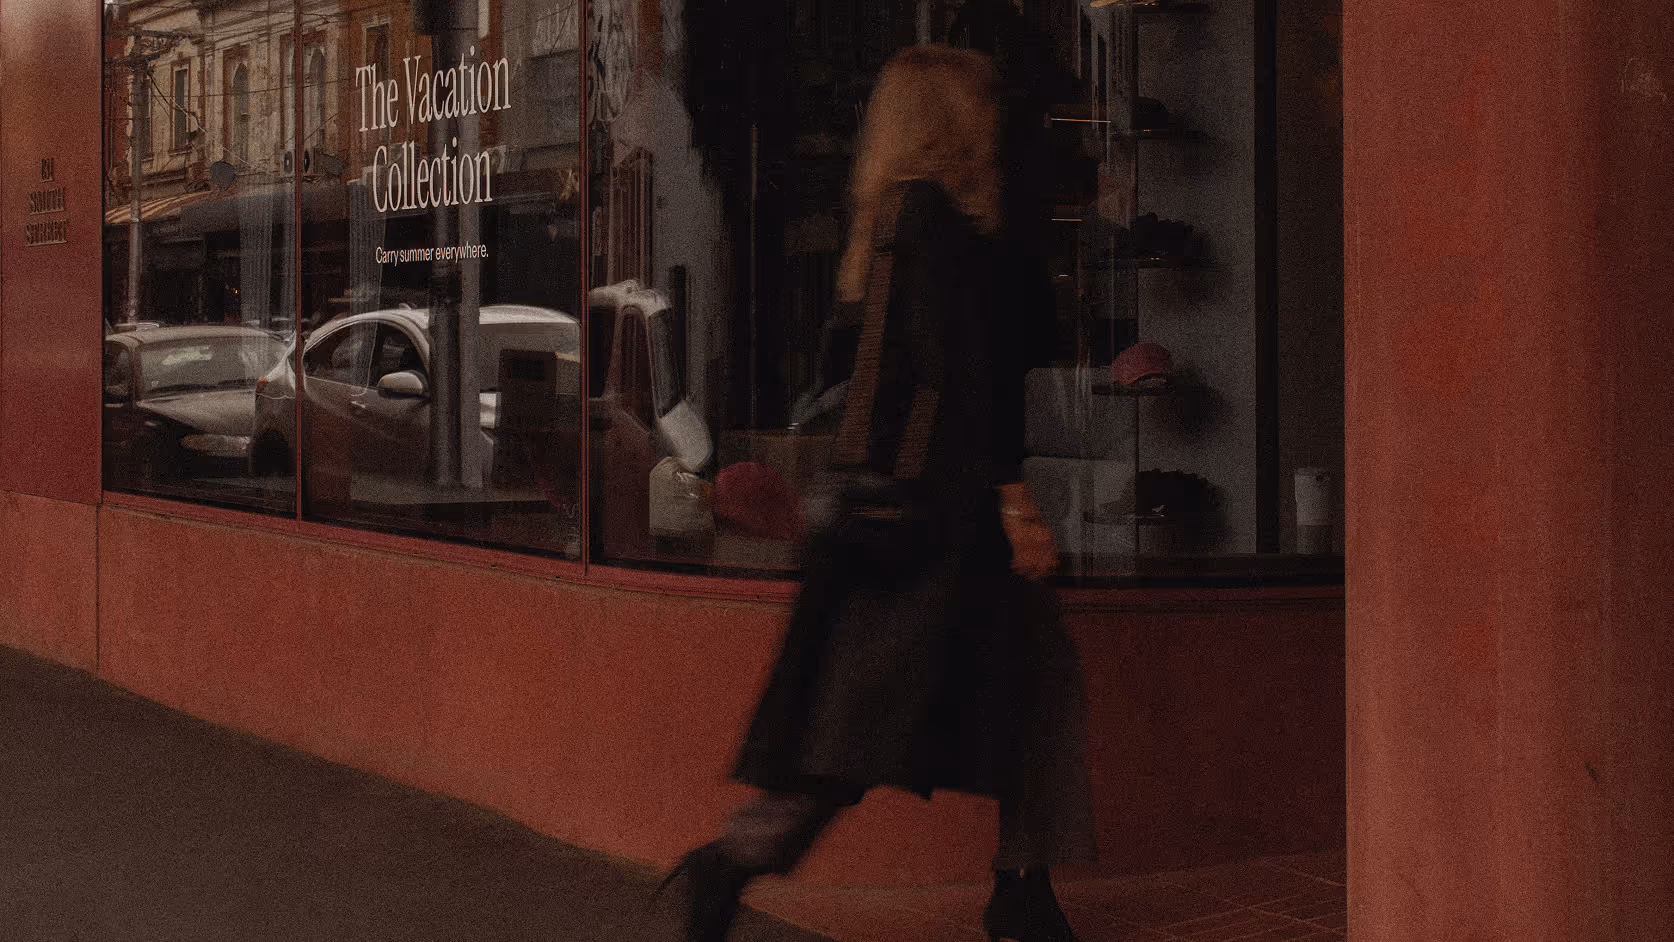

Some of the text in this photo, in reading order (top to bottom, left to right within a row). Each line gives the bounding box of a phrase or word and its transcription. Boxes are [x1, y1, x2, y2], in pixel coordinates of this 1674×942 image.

[356, 63, 399, 132] The
[402, 45, 512, 125] Vacation
[373, 136, 493, 213] Collection
[375, 240, 489, 267] Carry summer everywhere.
